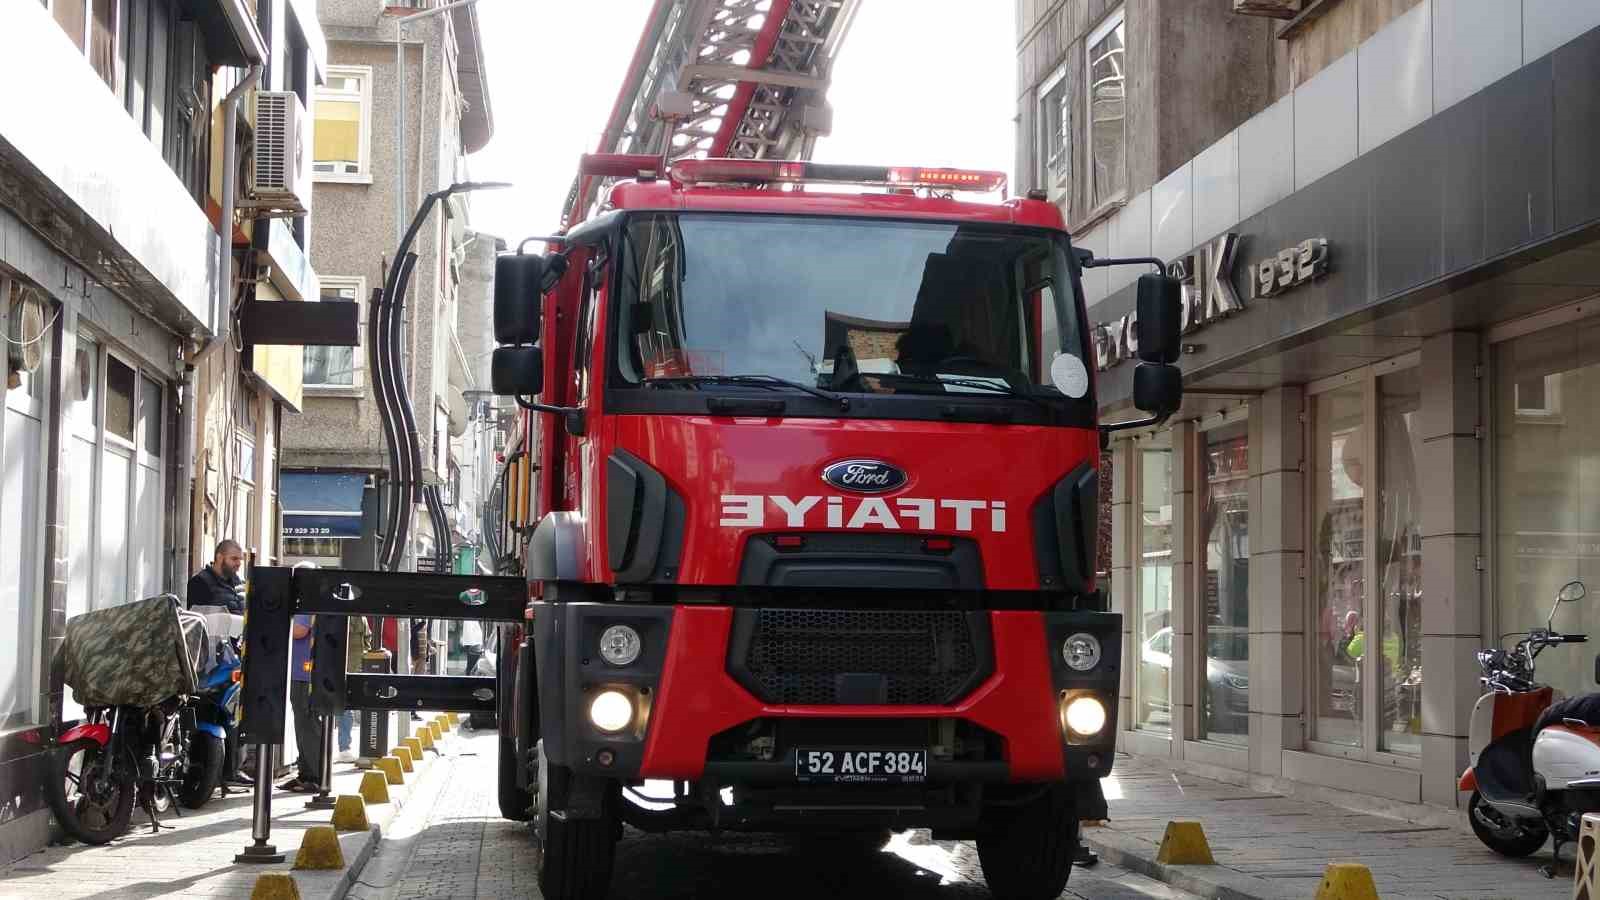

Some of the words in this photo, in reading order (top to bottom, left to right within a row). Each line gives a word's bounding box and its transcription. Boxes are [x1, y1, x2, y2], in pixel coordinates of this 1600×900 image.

[843, 464, 888, 485] Ford
[808, 751, 834, 773] 52
[841, 751, 881, 773] ACF
[884, 751, 923, 774] 384
